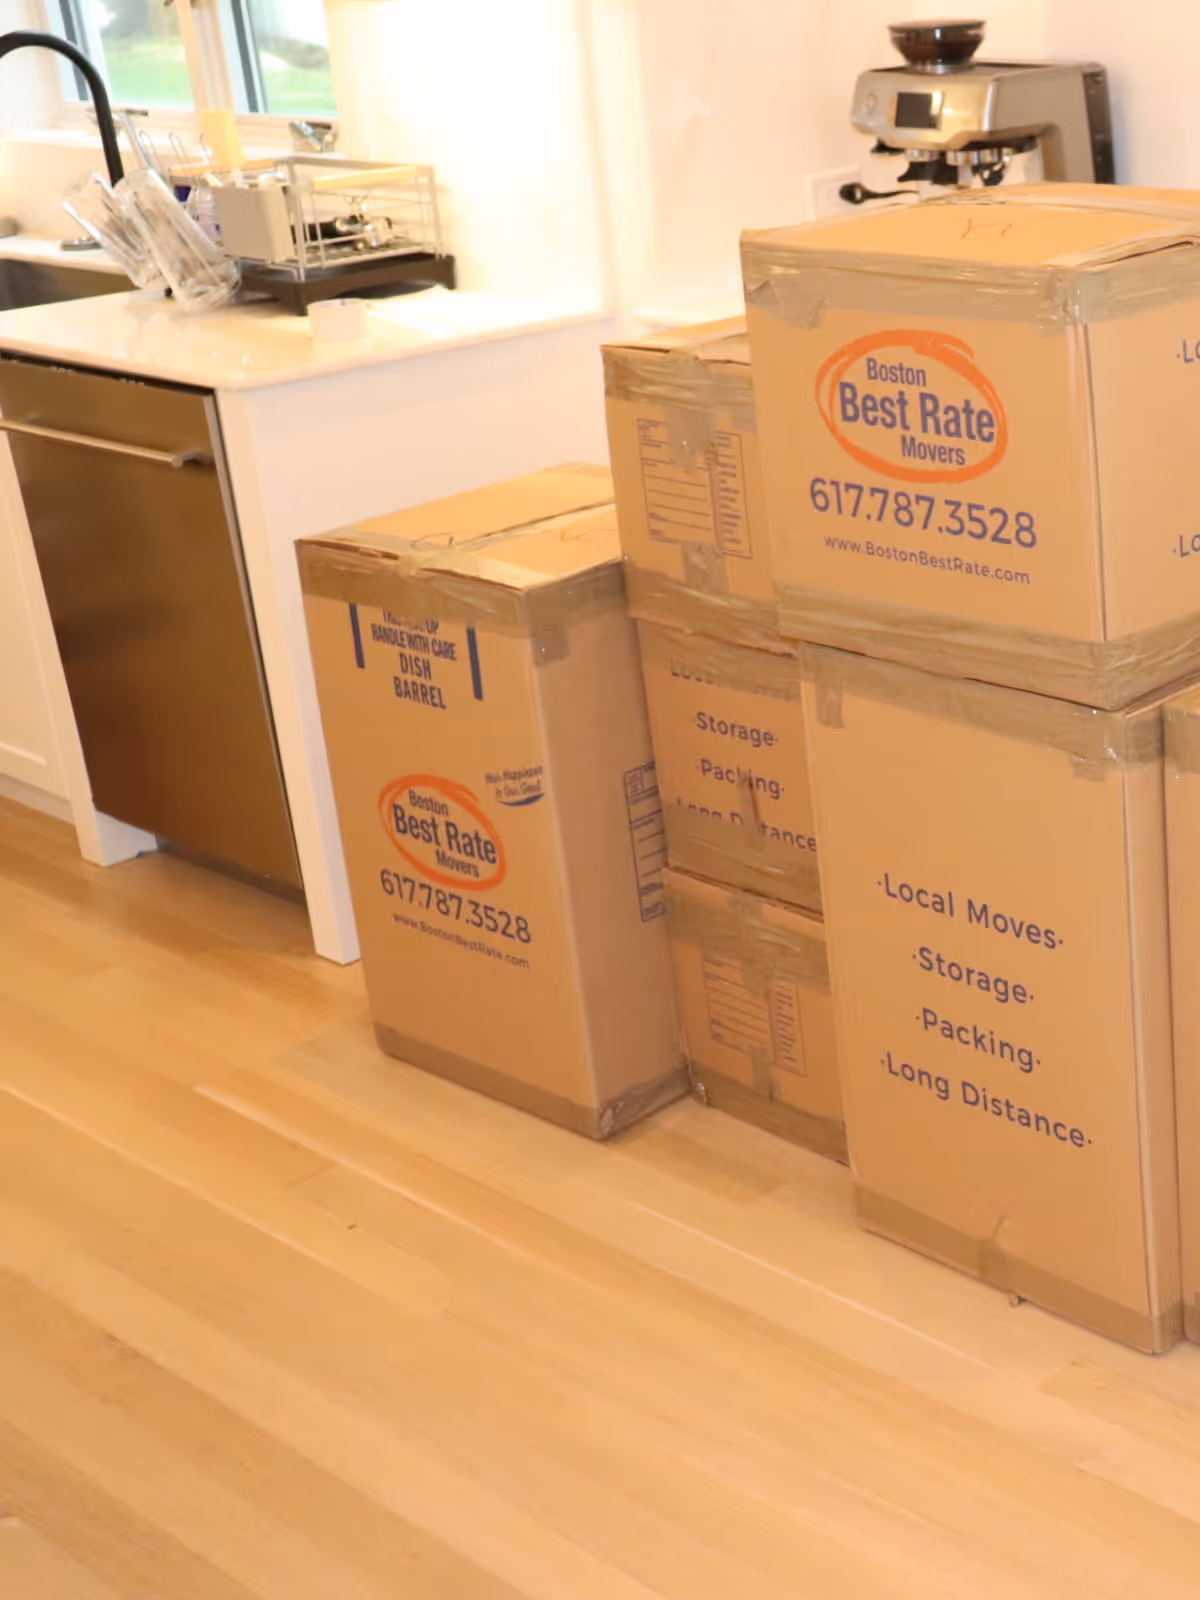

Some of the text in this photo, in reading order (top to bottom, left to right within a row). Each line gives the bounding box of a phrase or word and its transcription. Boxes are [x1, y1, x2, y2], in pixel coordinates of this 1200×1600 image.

[866, 357, 927, 387] Boston
[839, 381, 995, 443] Best Rate
[900, 435, 965, 466] Movers
[810, 477, 1037, 549] 617.787.3528
[824, 535, 1030, 584] www.BostonBestRate.com
[370, 623, 406, 649] HANDLE
[406, 632, 430, 654] WITH
[431, 638, 457, 661] CARE
[399, 652, 432, 681] DISH
[393, 676, 447, 709] BARREL
[408, 790, 449, 817] Boston
[393, 804, 497, 864] Best Rate
[436, 849, 480, 878] Movers
[381, 868, 531, 944] 617.787.3528
[393, 912, 530, 969] www.BostonBestRate.com
